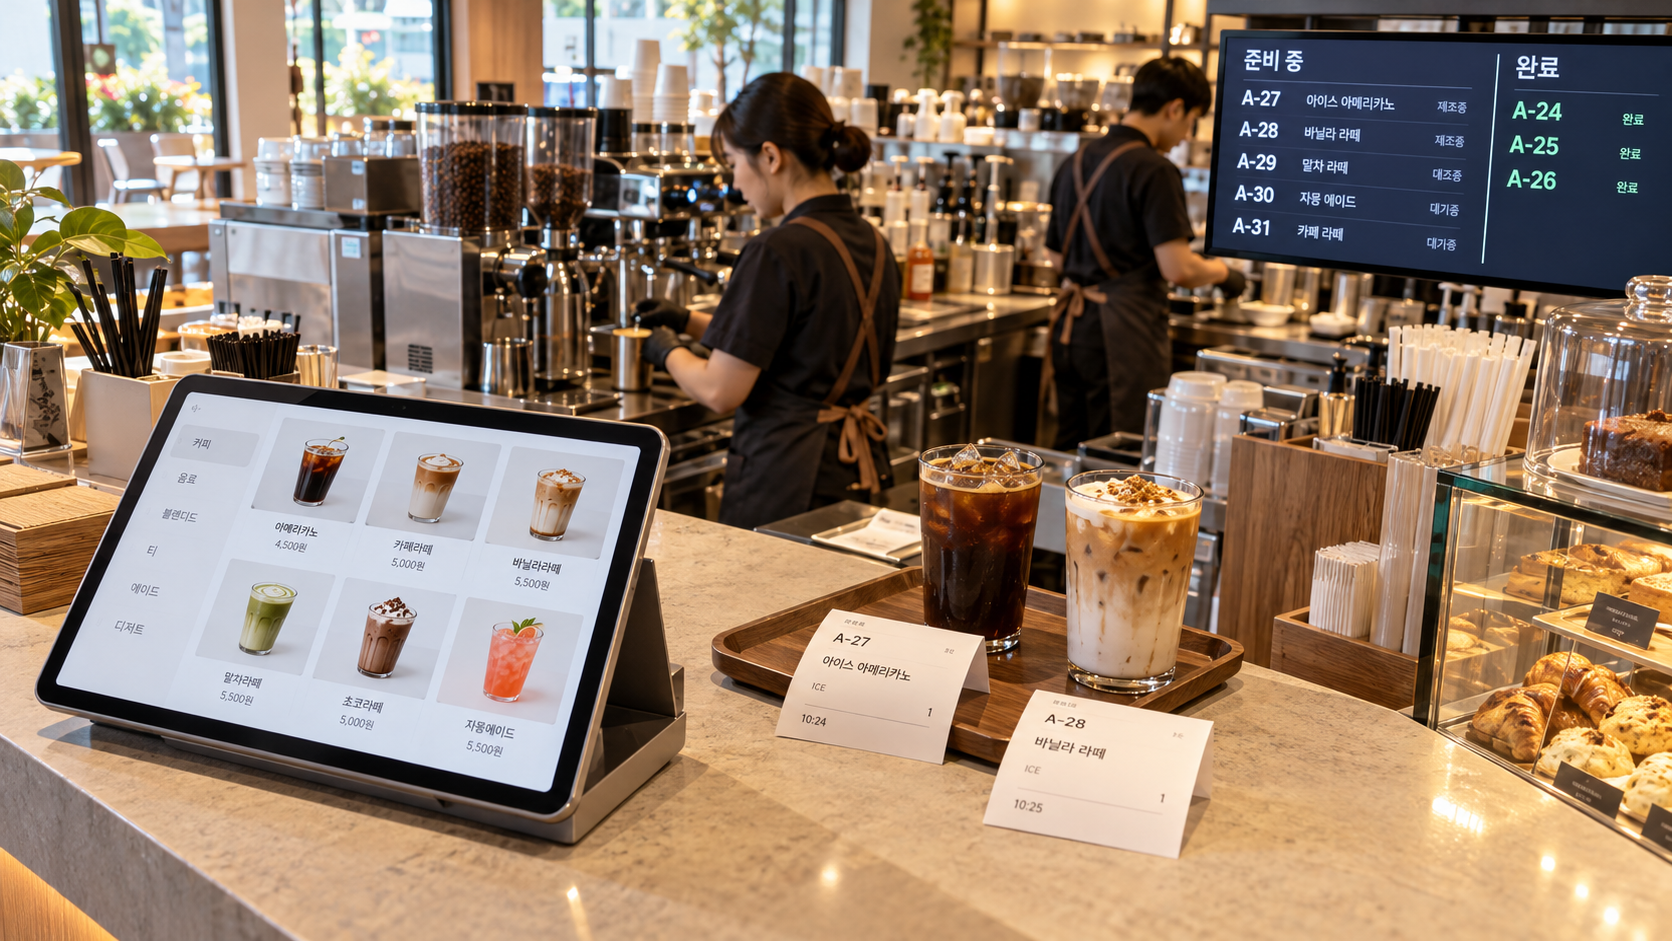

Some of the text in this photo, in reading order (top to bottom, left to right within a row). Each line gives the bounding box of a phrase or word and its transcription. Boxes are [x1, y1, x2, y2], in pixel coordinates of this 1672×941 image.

[1244, 50, 1303, 72] 준비 중
[1516, 55, 1559, 79] 완료
[1242, 90, 1281, 106] A-27
[1307, 95, 1395, 110] 아이스 아메리카노
[1512, 101, 1562, 121] A-24
[1623, 114, 1643, 125] 완료
[1239, 121, 1278, 138] A-28
[1305, 127, 1360, 142] 바닐라 라떼
[1509, 135, 1558, 155] A-25
[1620, 148, 1641, 159] 완료
[1237, 153, 1276, 171] A-29
[1303, 159, 1348, 174] 말차 라떼
[1507, 169, 1556, 190] A-26
[1235, 185, 1274, 203] A-30
[1617, 182, 1638, 193] 완료
[1324, 194, 1356, 208] 에이드
[1232, 217, 1269, 235] A-31
[1298, 225, 1343, 241] 카페 라떼
[193, 438, 211, 449] 커피
[178, 473, 197, 484] 음료
[147, 546, 158, 557] 티
[391, 558, 425, 571] 5,000원
[513, 558, 561, 574] 바닐라라떼
[131, 583, 159, 596] 에이드
[515, 577, 550, 591] 5,500원
[115, 621, 144, 635] 디저트
[833, 633, 870, 646] A-27
[823, 656, 910, 681] 아이스 아메리카노
[812, 682, 826, 692] ICE
[220, 691, 254, 706] 5,500원
[342, 696, 383, 714] 초코라떼
[802, 714, 826, 726] 10:24
[927, 708, 933, 717] 1
[340, 715, 374, 730] 5,000원
[1045, 714, 1085, 728] A-28
[466, 741, 503, 757] 5,500원
[1035, 737, 1106, 759] 바닐라 라떼
[1025, 764, 1041, 775] ICE
[1015, 799, 1043, 813] 10:25
[1160, 794, 1166, 803] 1
